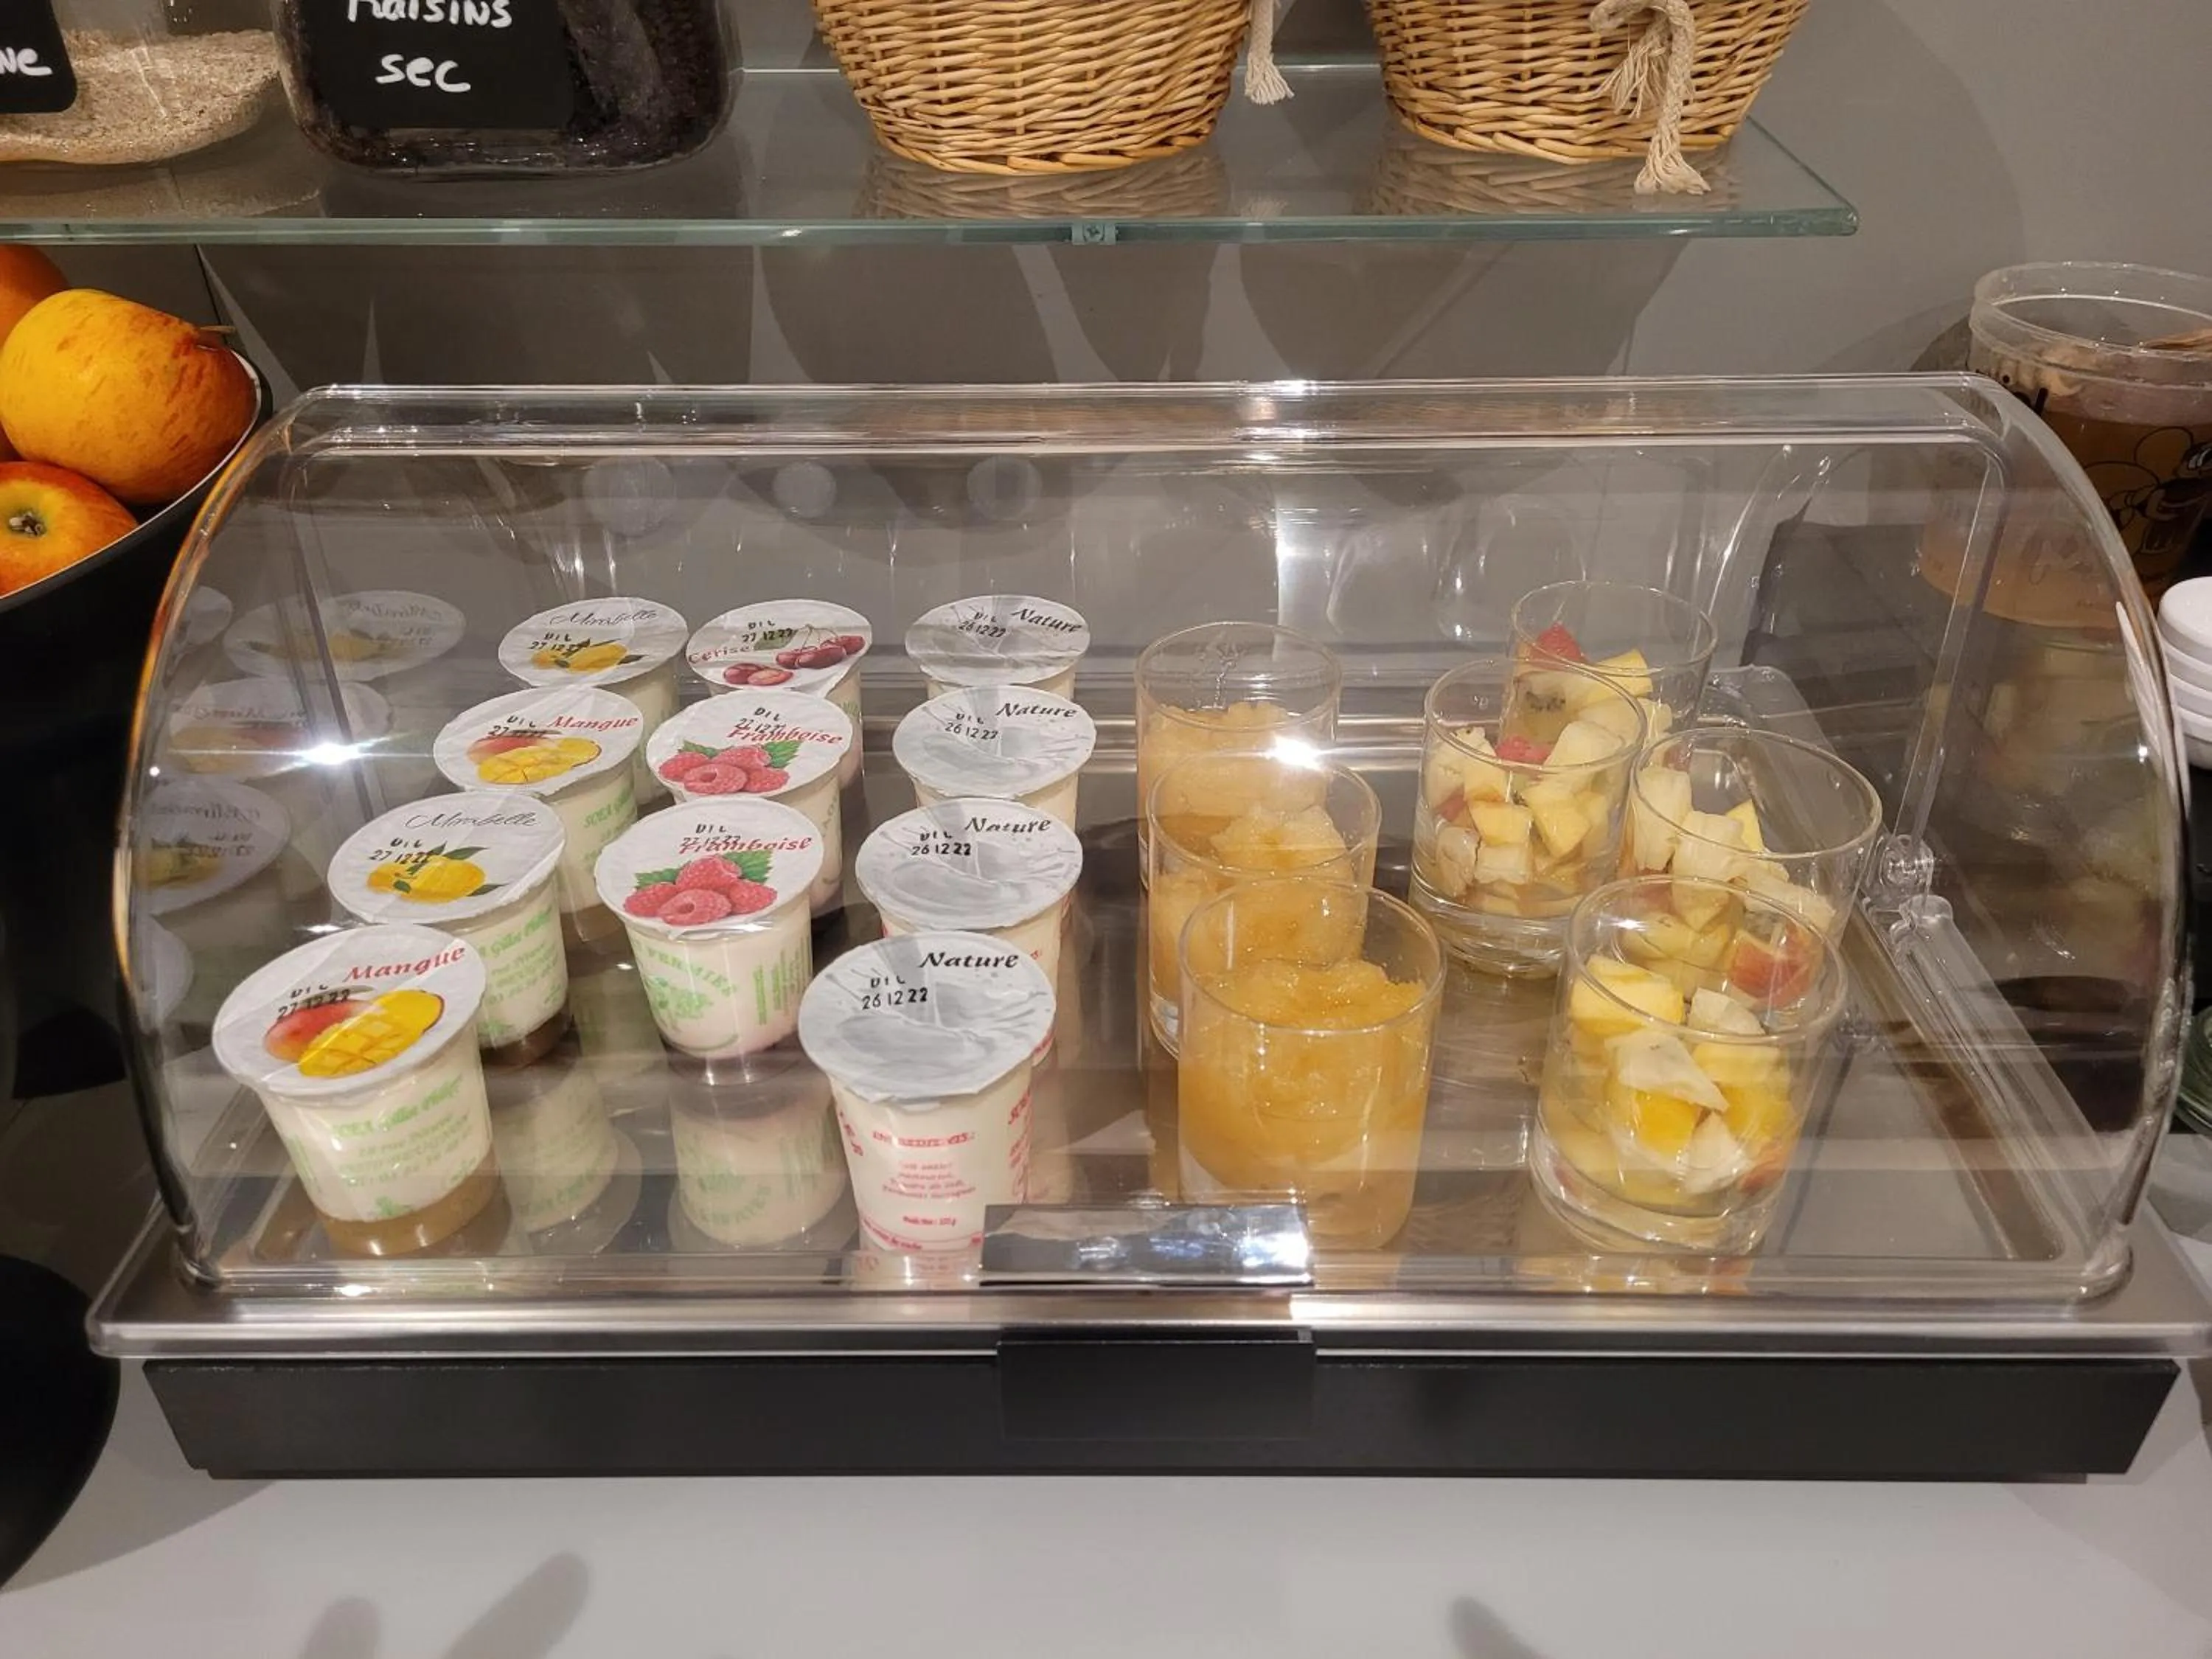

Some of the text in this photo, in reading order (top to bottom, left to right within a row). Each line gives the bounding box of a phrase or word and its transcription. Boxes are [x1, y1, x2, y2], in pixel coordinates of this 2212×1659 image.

[1011, 608, 1083, 633] Nature
[995, 702, 1079, 719] Nature
[546, 716, 639, 732] Mangue
[964, 816, 1052, 833] Nature
[679, 838, 813, 855] Framboise
[342, 946, 467, 983] Mangue
[918, 951, 1020, 969] Nature
